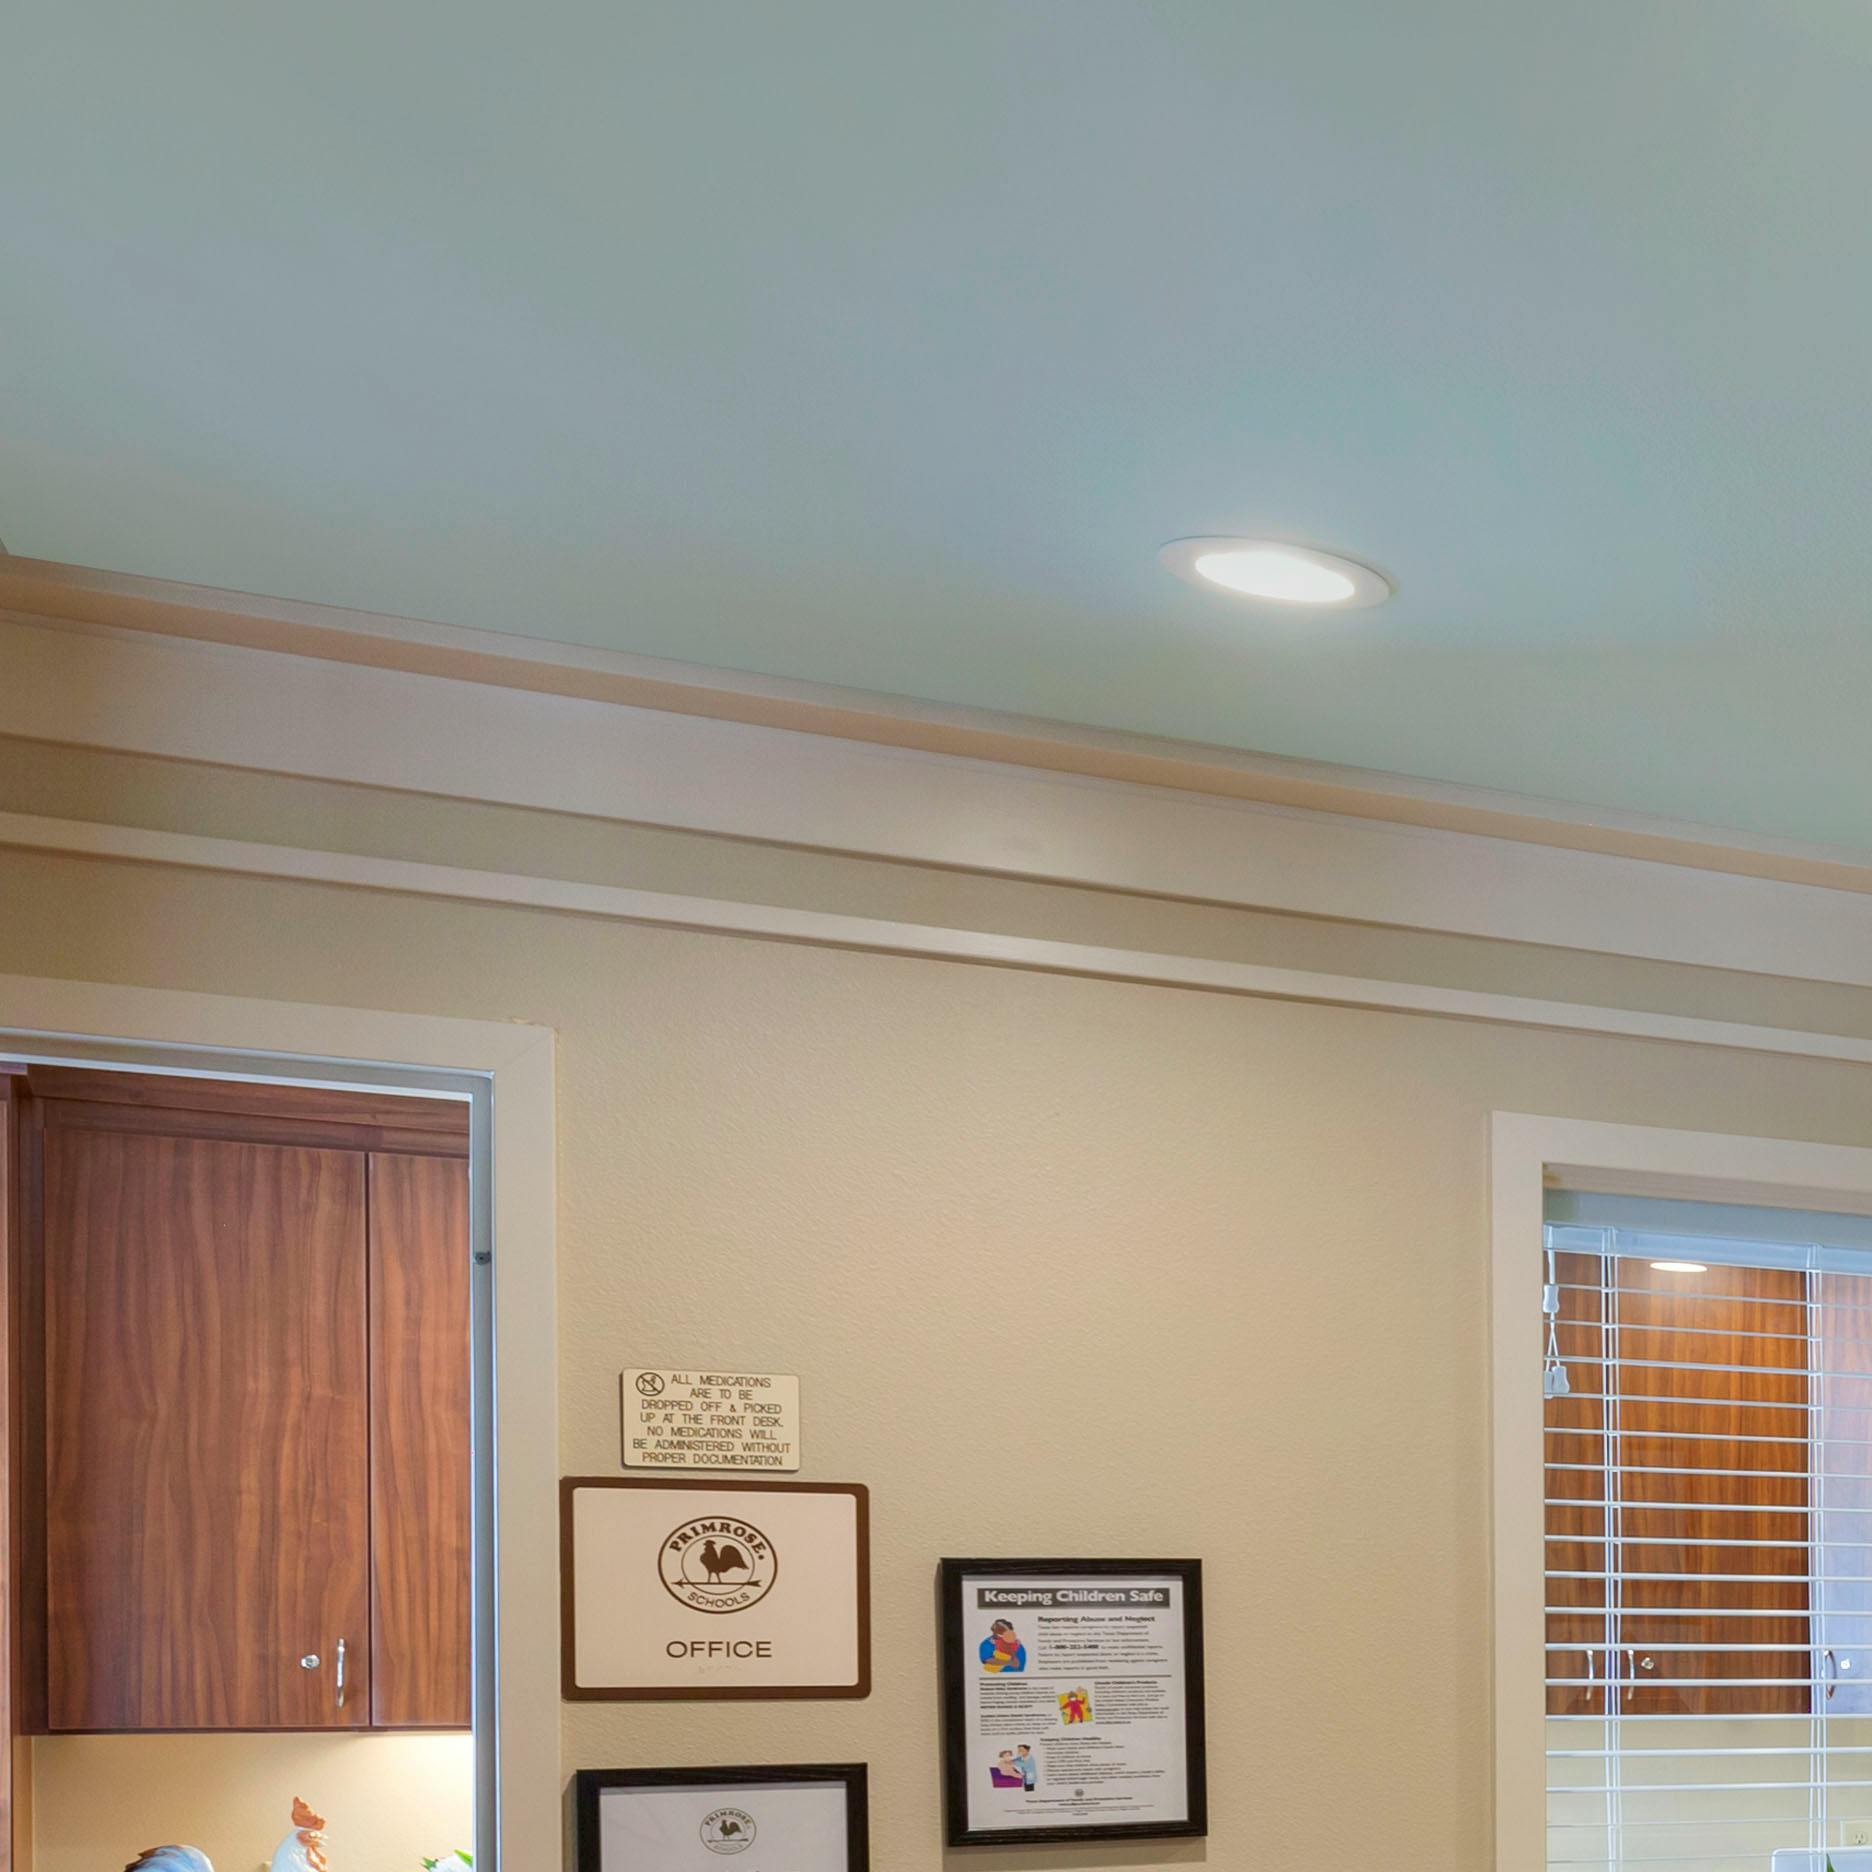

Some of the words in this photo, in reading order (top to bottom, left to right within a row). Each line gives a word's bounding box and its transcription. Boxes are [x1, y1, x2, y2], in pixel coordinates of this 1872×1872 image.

[671, 1374, 693, 1385] ALL
[700, 1375, 772, 1388] MEDICATIONS
[690, 1388, 712, 1399] ARE
[719, 1389, 732, 1400] TO
[738, 1389, 753, 1400] BE
[641, 1399, 693, 1412] DROPPED
[700, 1401, 722, 1412] OFF
[729, 1404, 737, 1413] &
[744, 1403, 782, 1414] PICKED
[640, 1412, 656, 1423] UP
[662, 1413, 674, 1424] AT
[683, 1413, 703, 1424] THE
[710, 1415, 746, 1426] FRONT
[753, 1416, 784, 1427] DESK.
[646, 1426, 663, 1436] NO
[670, 1427, 742, 1439] MEDICATIONS
[749, 1429, 777, 1440] WILL
[632, 1439, 647, 1449] BE
[654, 1439, 735, 1451] ADMINISTERED
[741, 1442, 791, 1454] WITHOUT
[642, 1452, 686, 1464] PROPER
[693, 1453, 783, 1466] DOCUMENTATION
[687, 1591, 751, 1608] SCHOOLS
[984, 1590, 1053, 1605] Keeping
[1056, 1590, 1126, 1602] Children
[1130, 1590, 1164, 1602] Safe
[1038, 1616, 1079, 1624] Reporting
[666, 1640, 772, 1658] OFFICE
